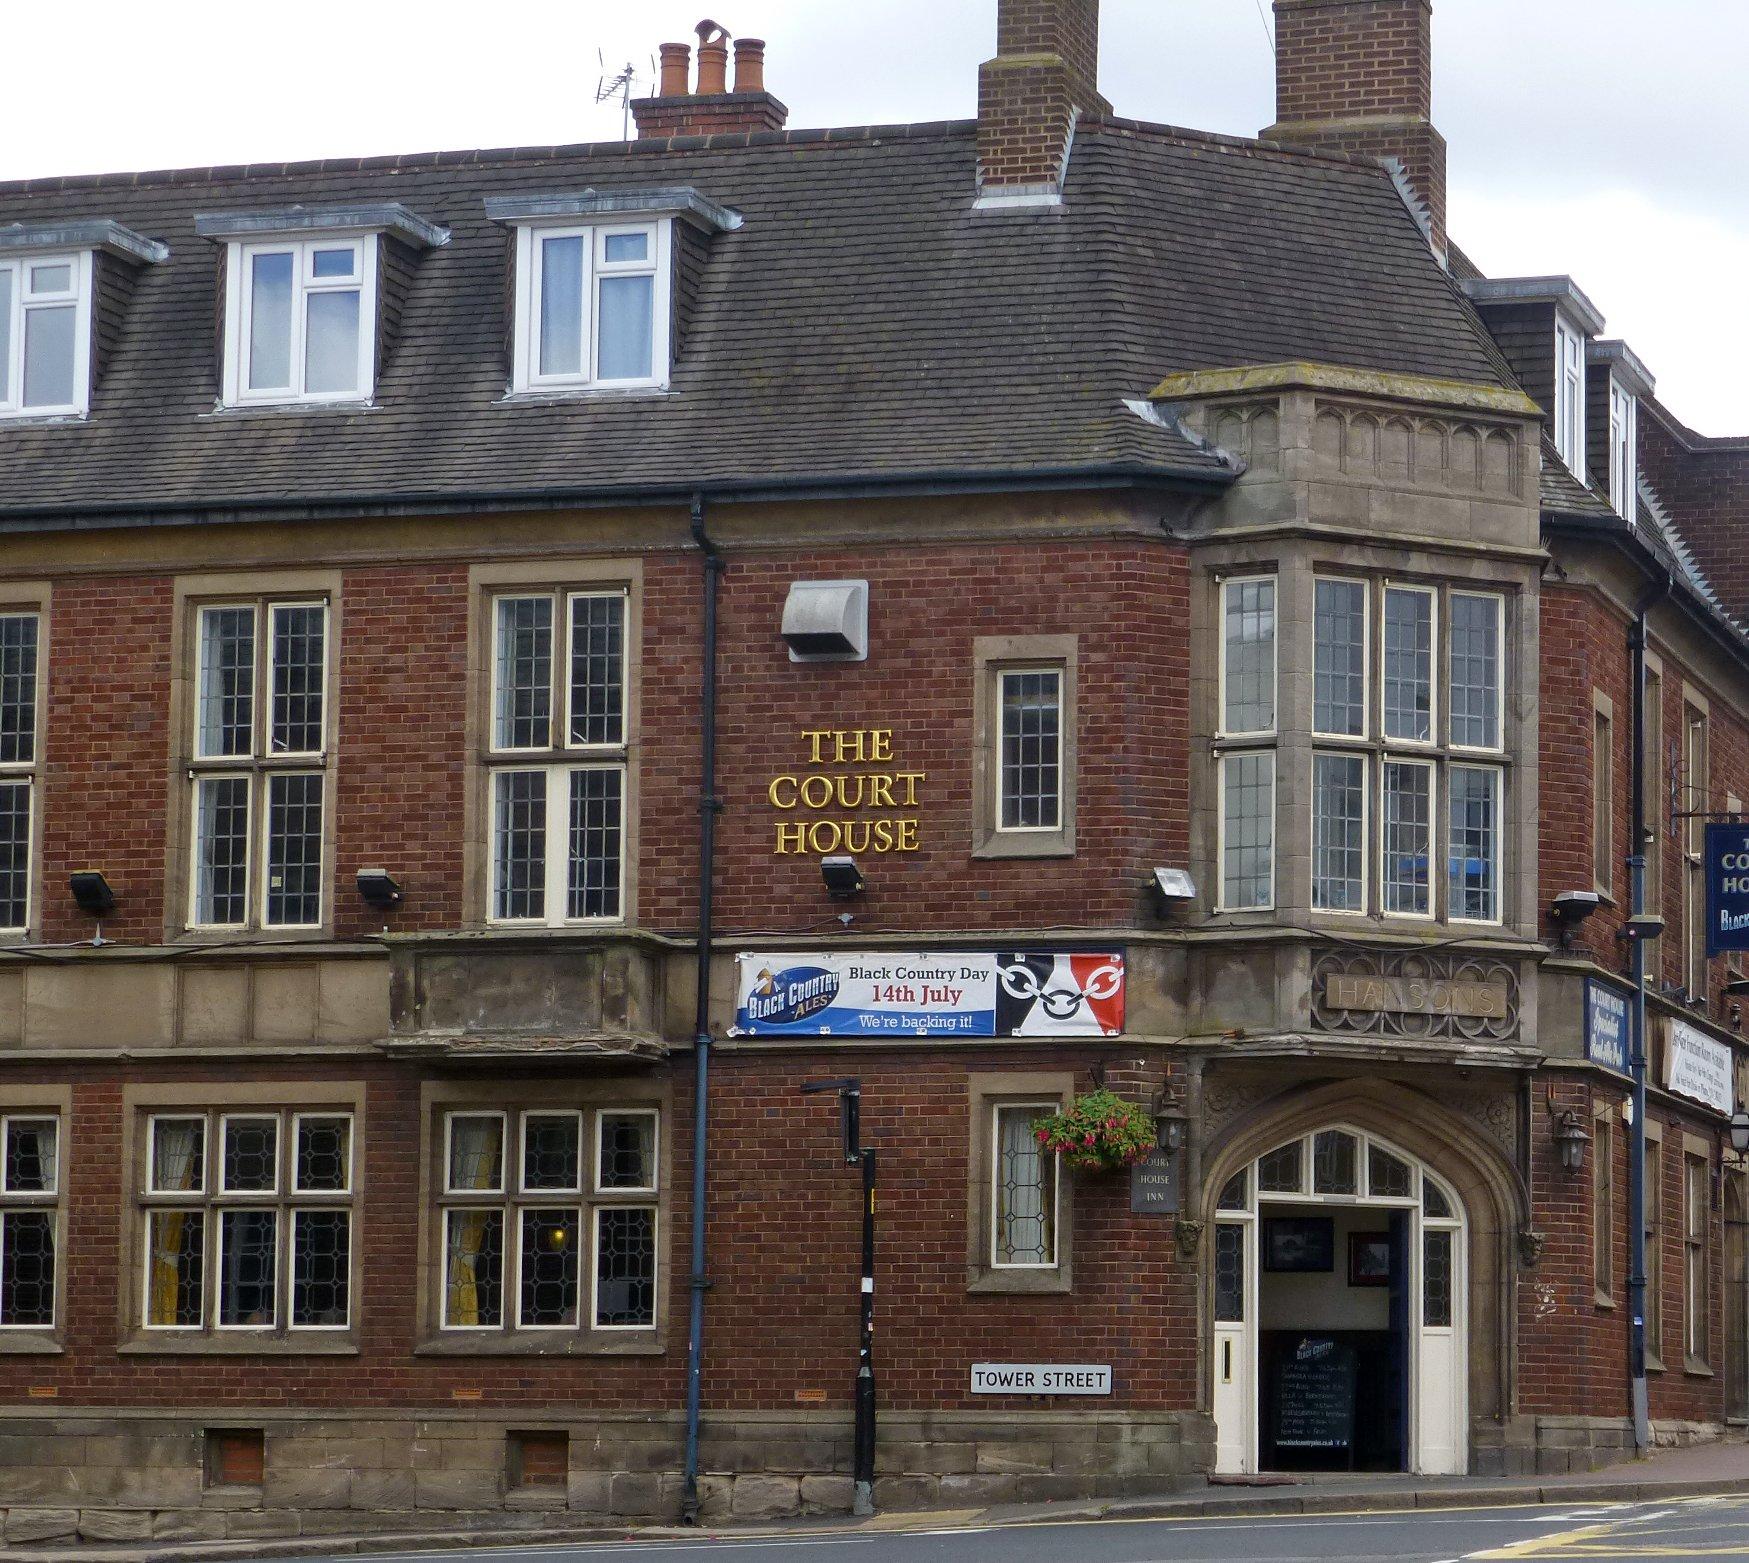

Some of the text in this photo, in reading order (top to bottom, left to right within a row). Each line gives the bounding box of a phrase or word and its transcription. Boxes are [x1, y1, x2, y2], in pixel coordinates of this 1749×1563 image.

[801, 729, 894, 763] THE
[768, 773, 926, 809] COURT
[773, 819, 920, 854] HOUSE
[849, 967, 990, 982] Black Country Day
[749, 973, 840, 1019] BLACK COUNTRY
[872, 984, 963, 1006] 14th July
[1338, 980, 1495, 1013] HANSONS
[794, 995, 828, 1020] ALES
[859, 1014, 973, 1031] We're backing it!
[1140, 1175, 1170, 1184] HOUSE
[1147, 1192, 1165, 1201] INN
[975, 1371, 1106, 1388] TOWER STREET
